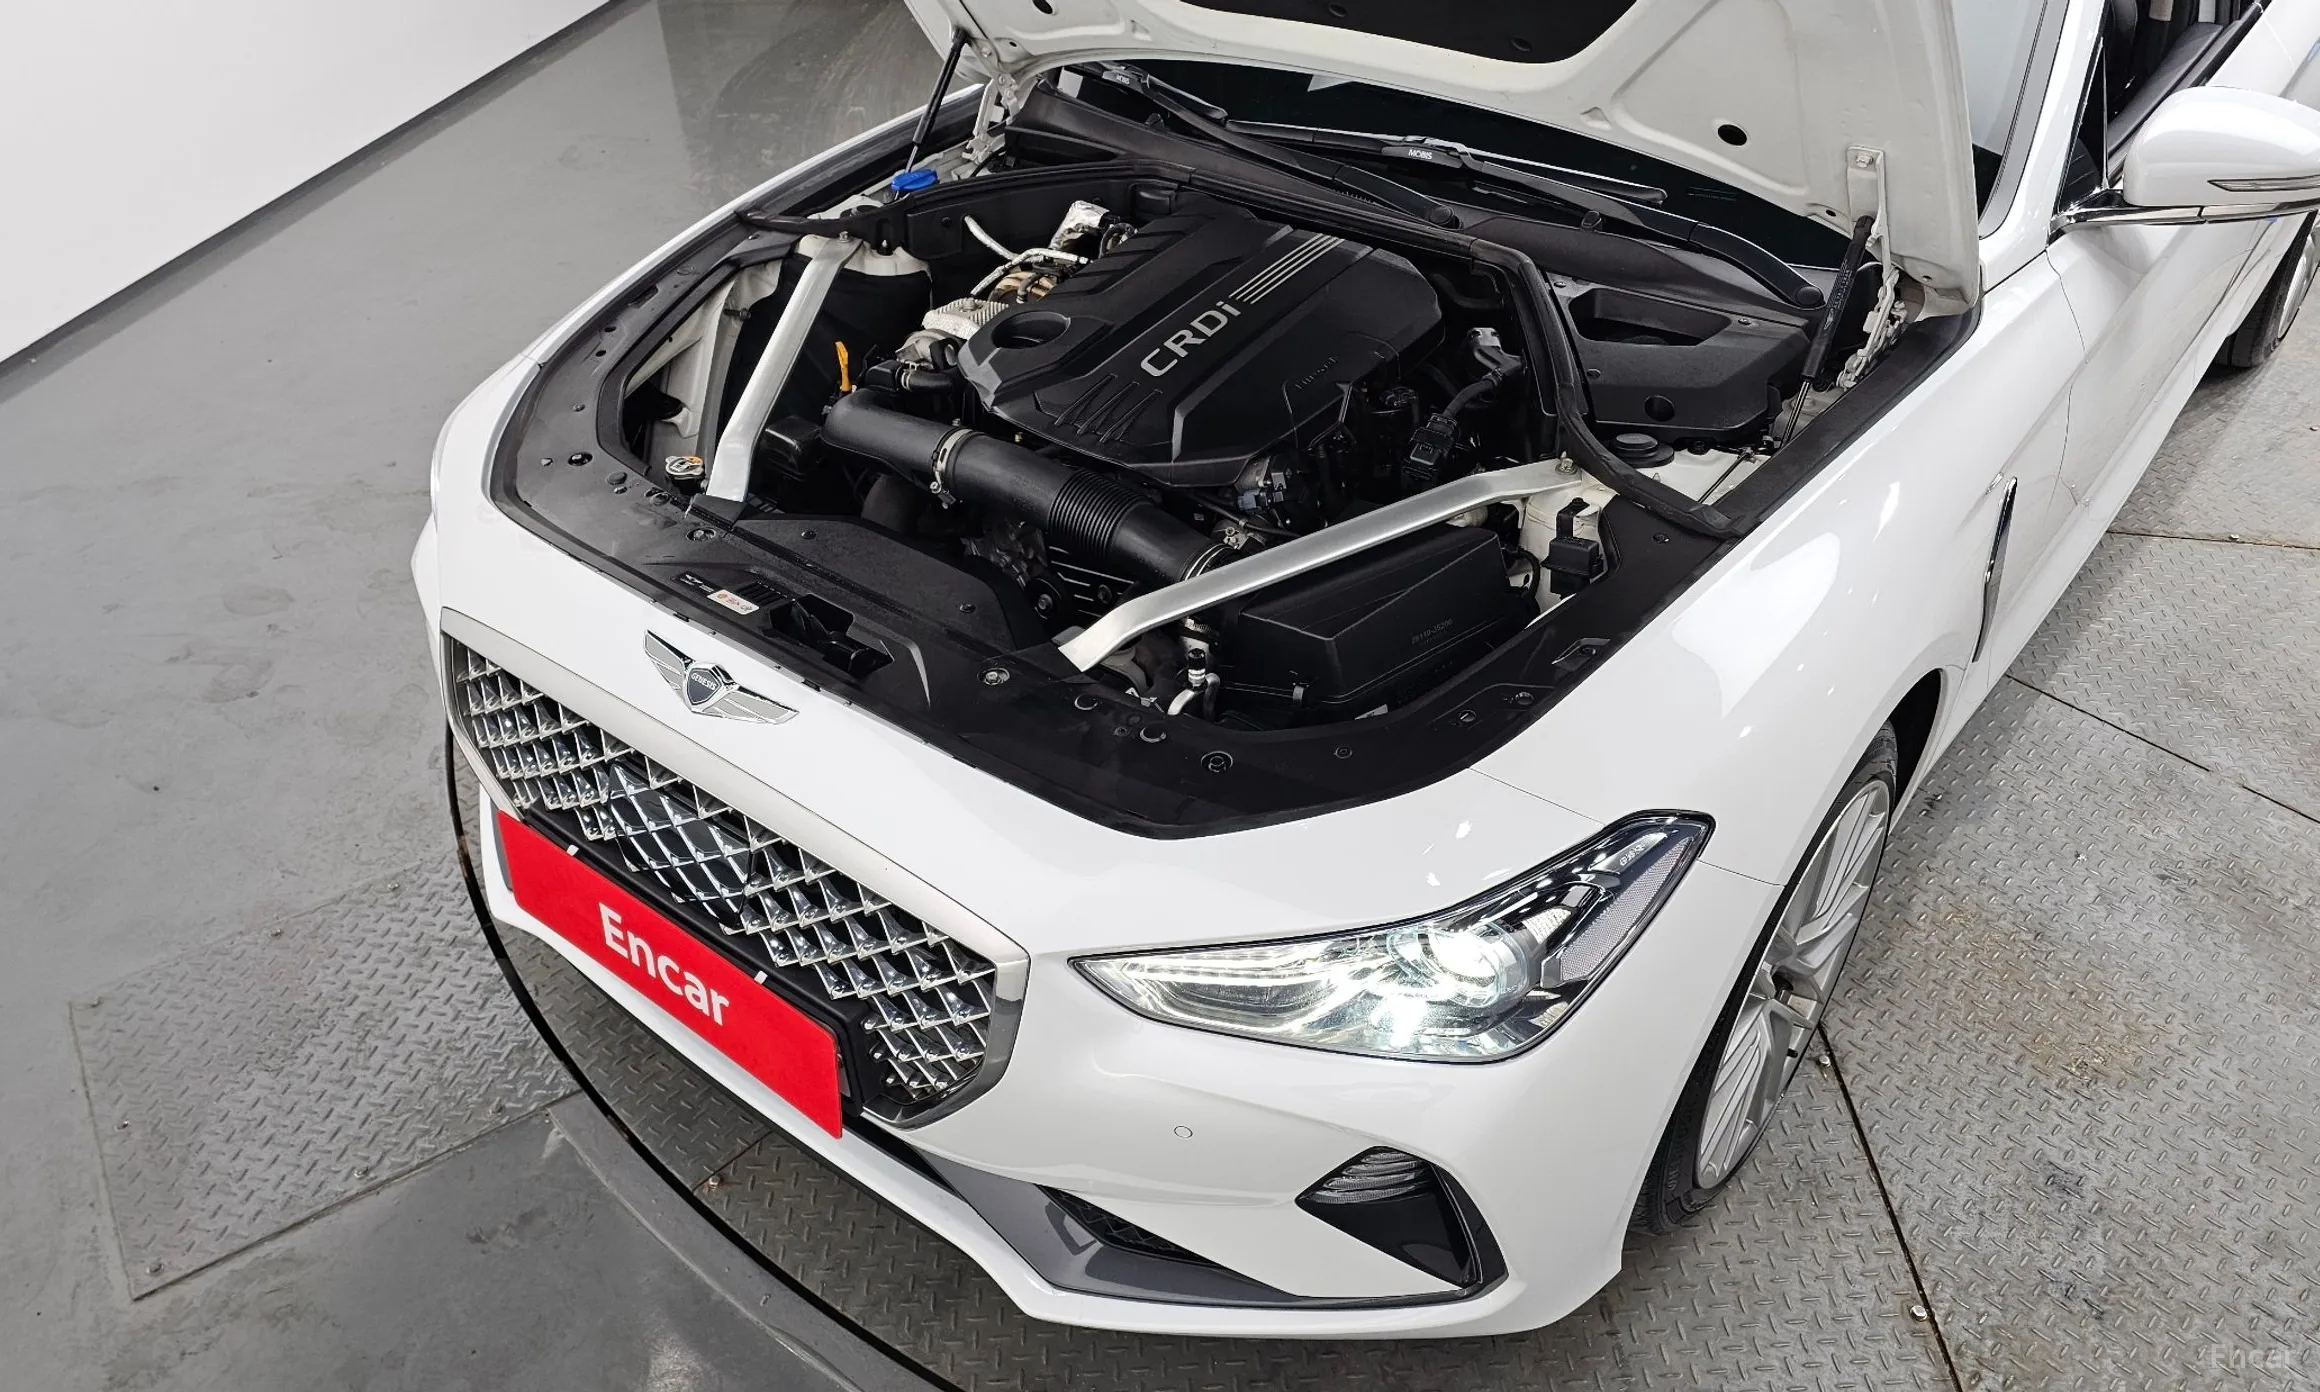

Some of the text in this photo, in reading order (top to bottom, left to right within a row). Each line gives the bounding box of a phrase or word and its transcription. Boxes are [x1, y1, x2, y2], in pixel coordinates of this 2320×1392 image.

[1408, 149, 1433, 160] MOBIS
[1140, 300, 1241, 377] CRDi
[691, 672, 717, 691] GENESIS
[598, 901, 730, 1027] Encar
